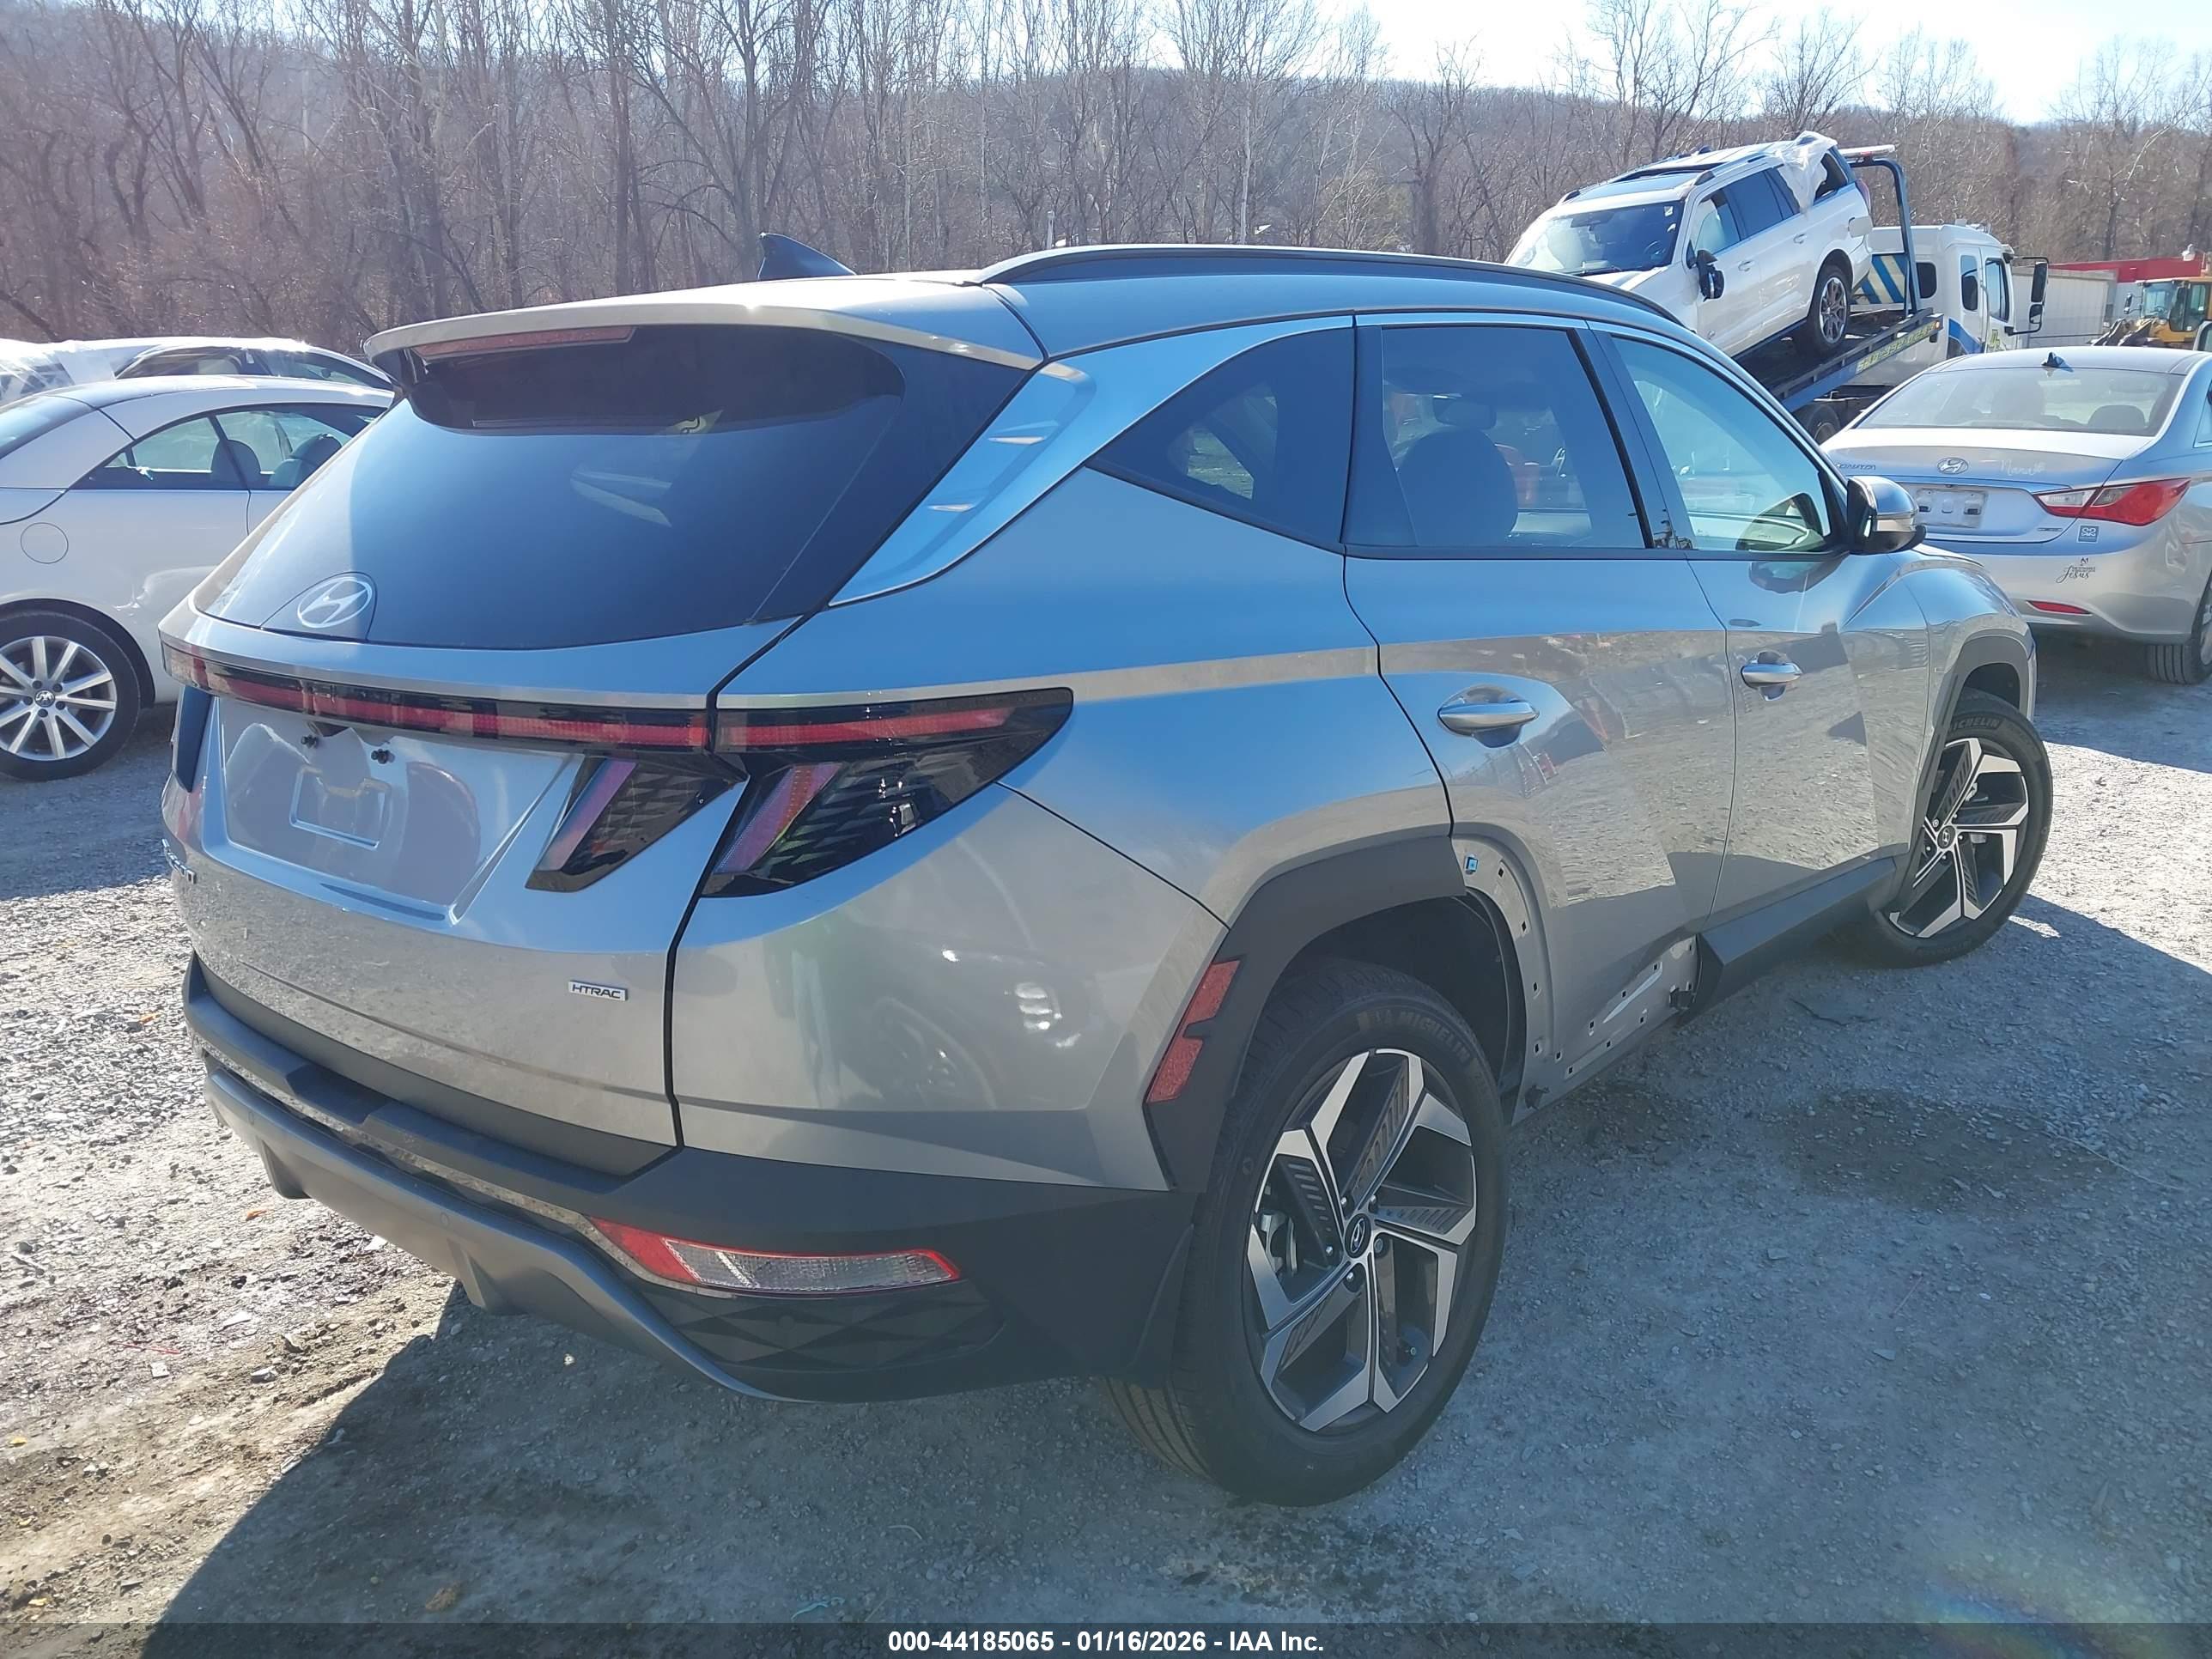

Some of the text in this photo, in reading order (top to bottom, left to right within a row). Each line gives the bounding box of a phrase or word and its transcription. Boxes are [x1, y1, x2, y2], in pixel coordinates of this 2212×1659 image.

[2056, 565, 2090, 584] Jesus
[572, 984, 622, 1000] HTRAC
[1399, 1010, 1471, 1066] MICHELIN
